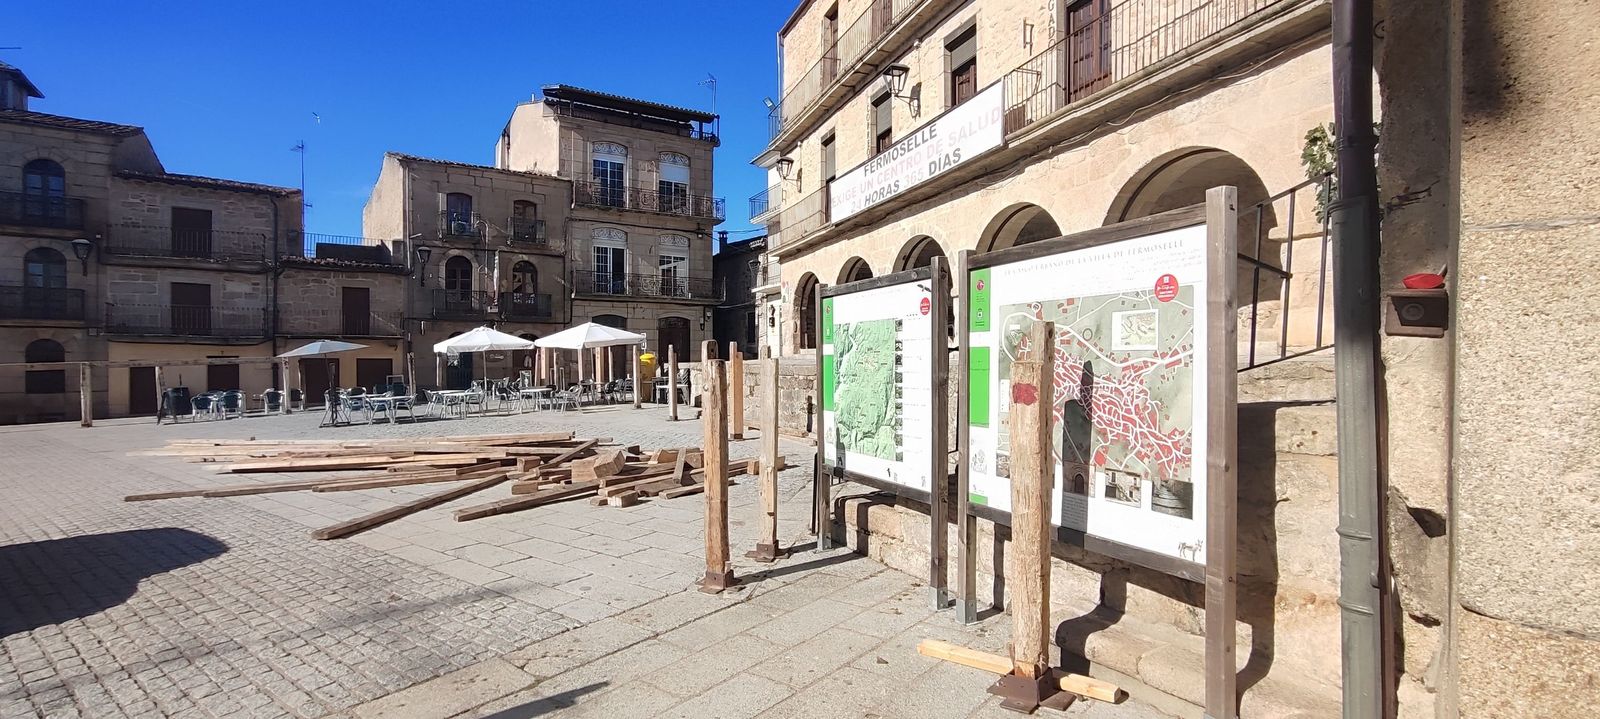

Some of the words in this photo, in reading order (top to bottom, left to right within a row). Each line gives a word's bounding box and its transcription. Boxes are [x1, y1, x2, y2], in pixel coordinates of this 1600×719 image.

[831, 186, 857, 208] EXIGE
[860, 176, 874, 194] UN
[877, 153, 922, 186] CENTRO
[926, 140, 944, 158] DE
[948, 106, 1001, 147] SALUD
[863, 123, 938, 177] FERMOSELLE
[864, 179, 900, 208] HORAS
[904, 168, 925, 189] 365
[928, 147, 962, 177] DÍAS
